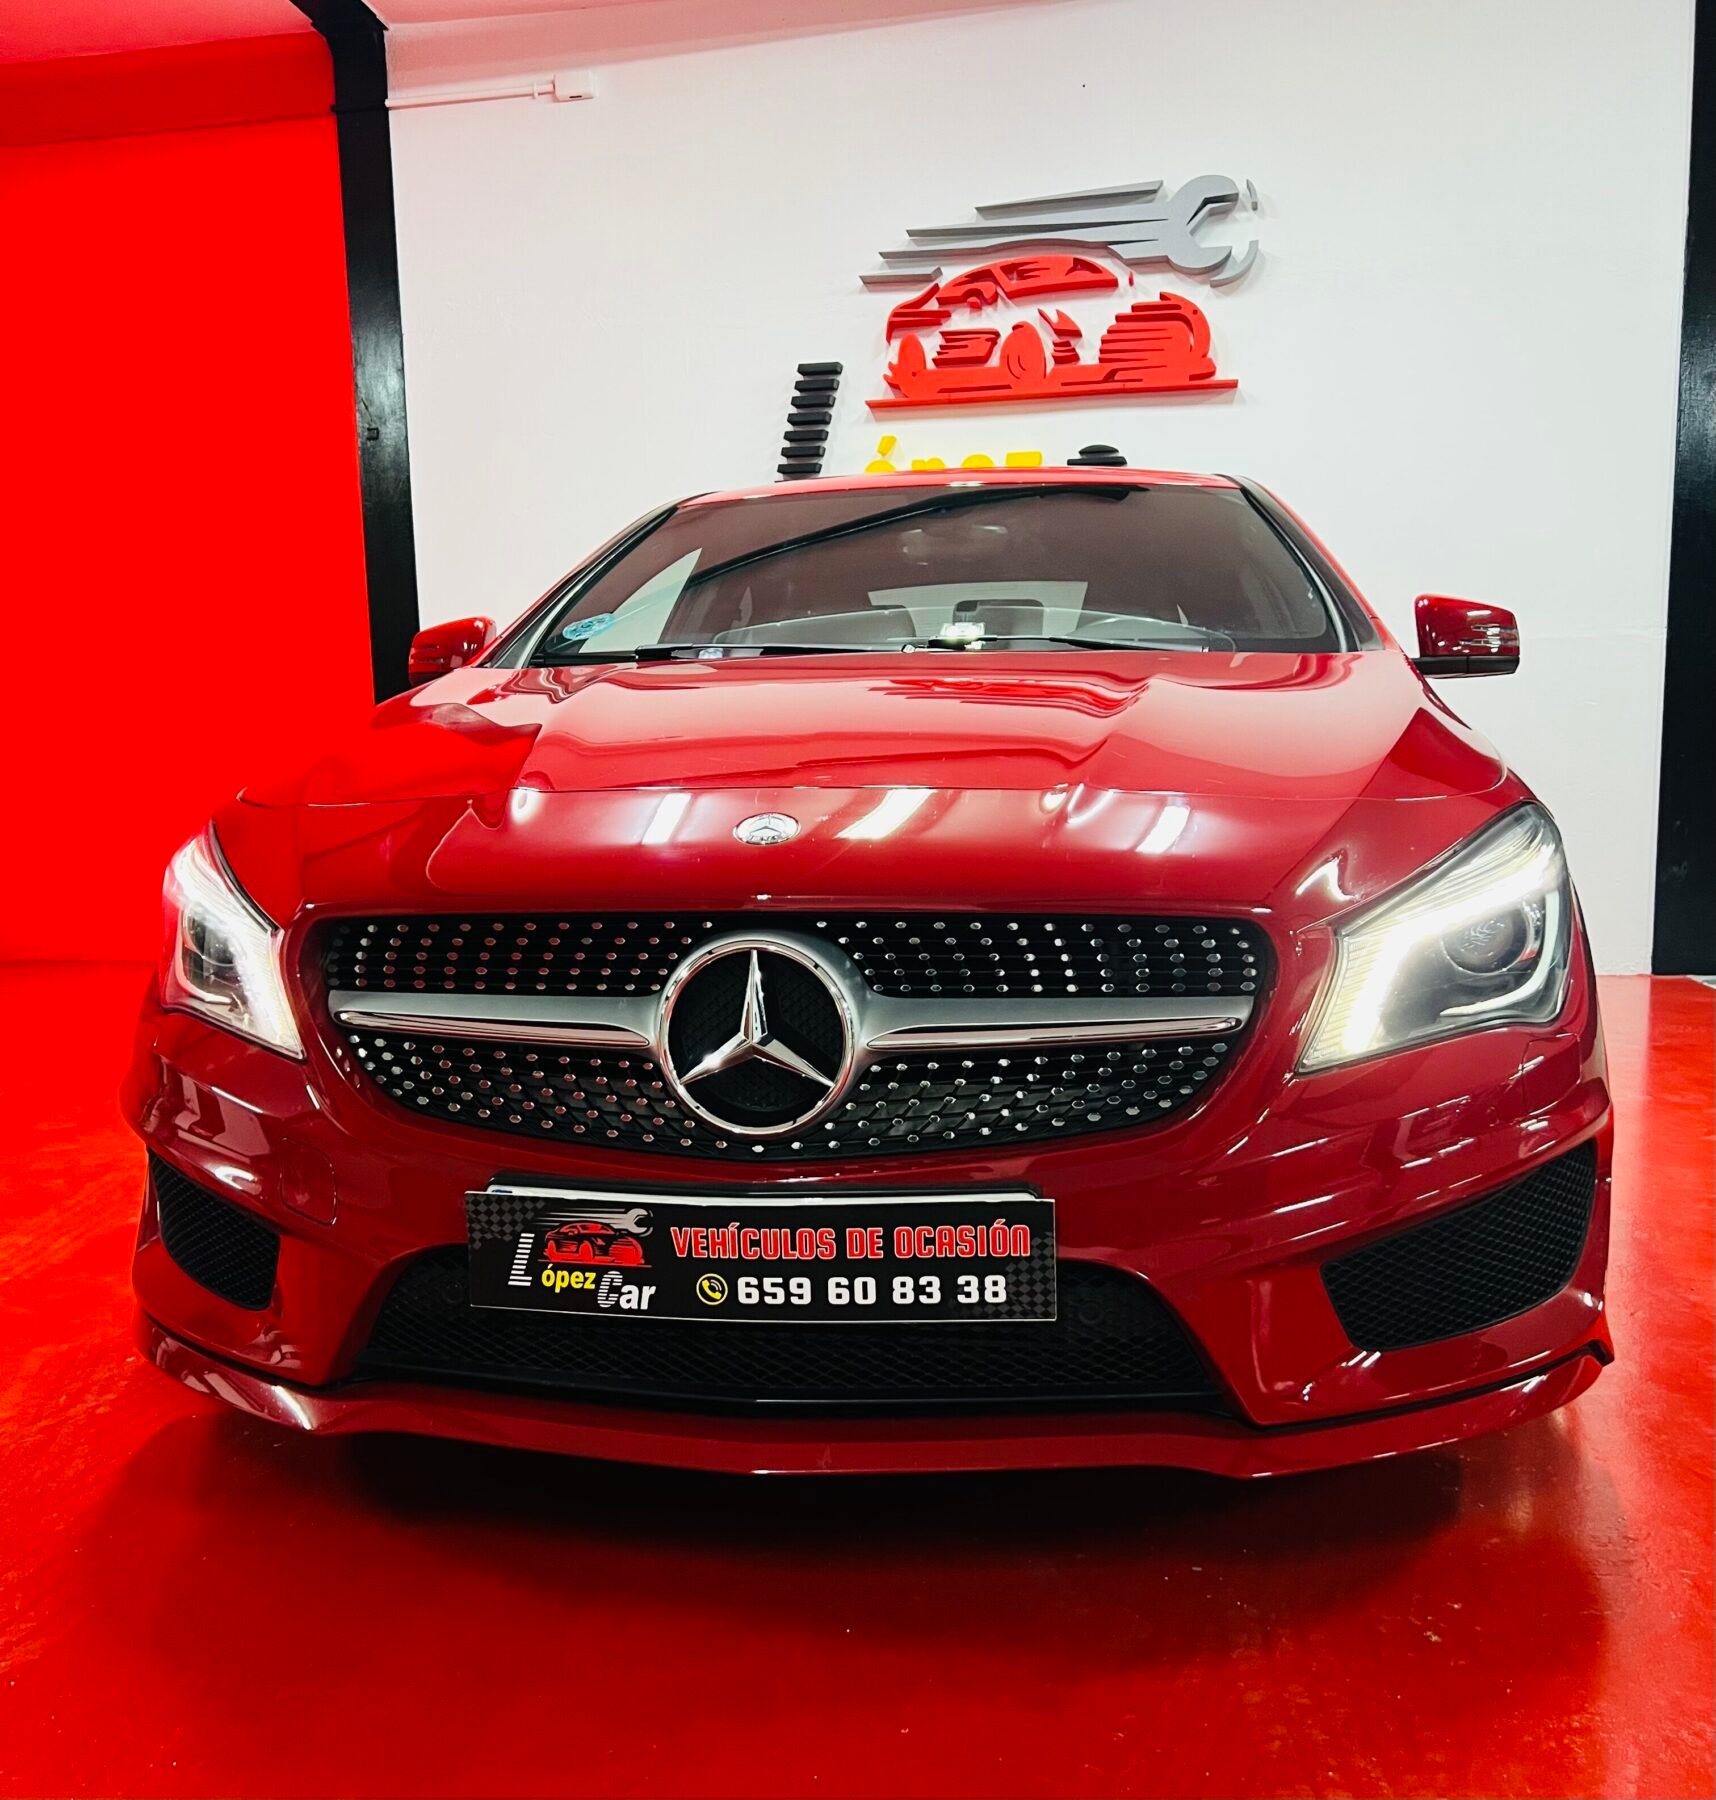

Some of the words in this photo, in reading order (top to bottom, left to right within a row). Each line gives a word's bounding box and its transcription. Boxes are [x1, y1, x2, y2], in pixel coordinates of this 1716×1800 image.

[670, 1222, 837, 1260] VEHÍCULOS
[846, 1227, 884, 1259] DE
[893, 1218, 1031, 1259] OCASIÓN
[597, 1270, 657, 1310] Car
[737, 1276, 812, 1305] 659
[827, 1276, 877, 1305] 60
[892, 1275, 942, 1304] 83
[957, 1275, 1007, 1304] 38
